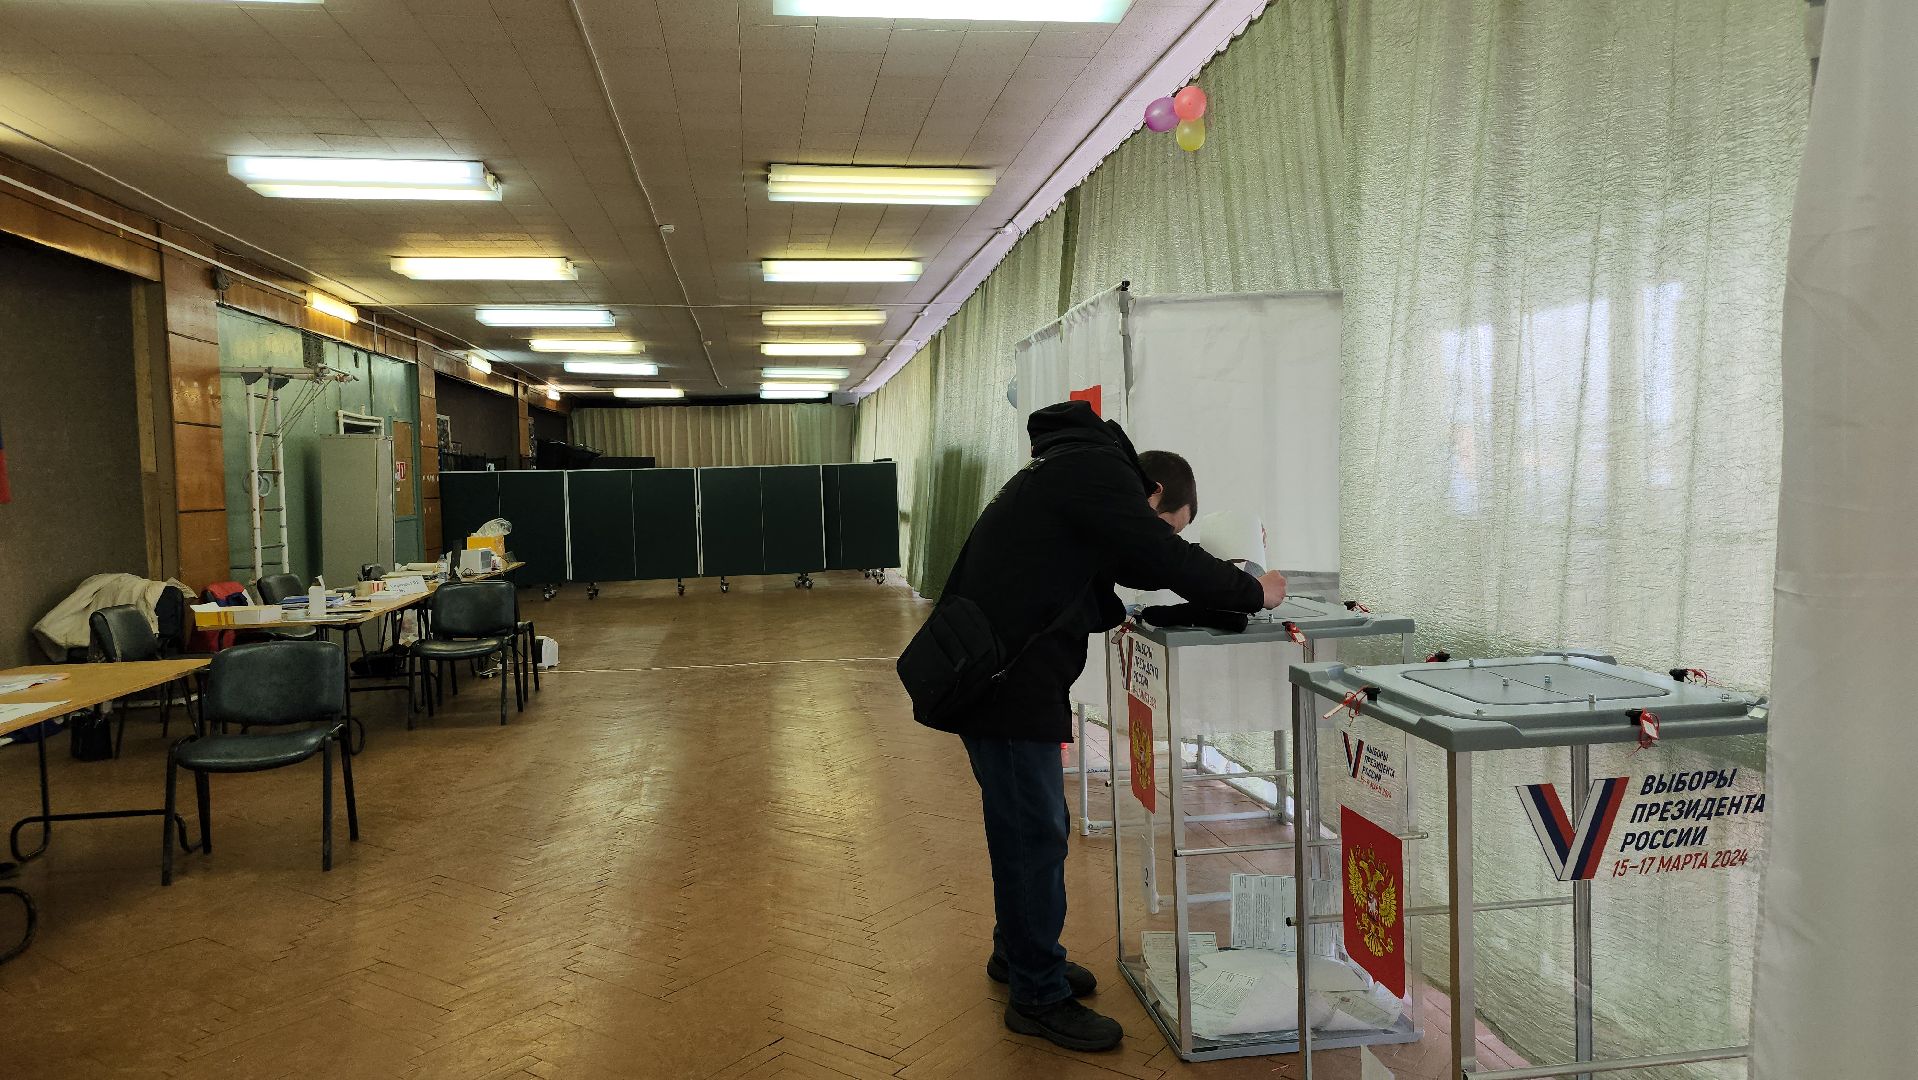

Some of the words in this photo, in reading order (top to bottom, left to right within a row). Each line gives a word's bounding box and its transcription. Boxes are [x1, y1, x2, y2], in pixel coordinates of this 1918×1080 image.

[1639, 768, 1738, 796] ВЫБОРЫ
[1629, 793, 1766, 824] ПРЕЗИДЕНТА
[1619, 825, 1708, 852] РОССИИ
[1656, 851, 1707, 873] МАРТА
[1711, 848, 1748, 869] 2024
